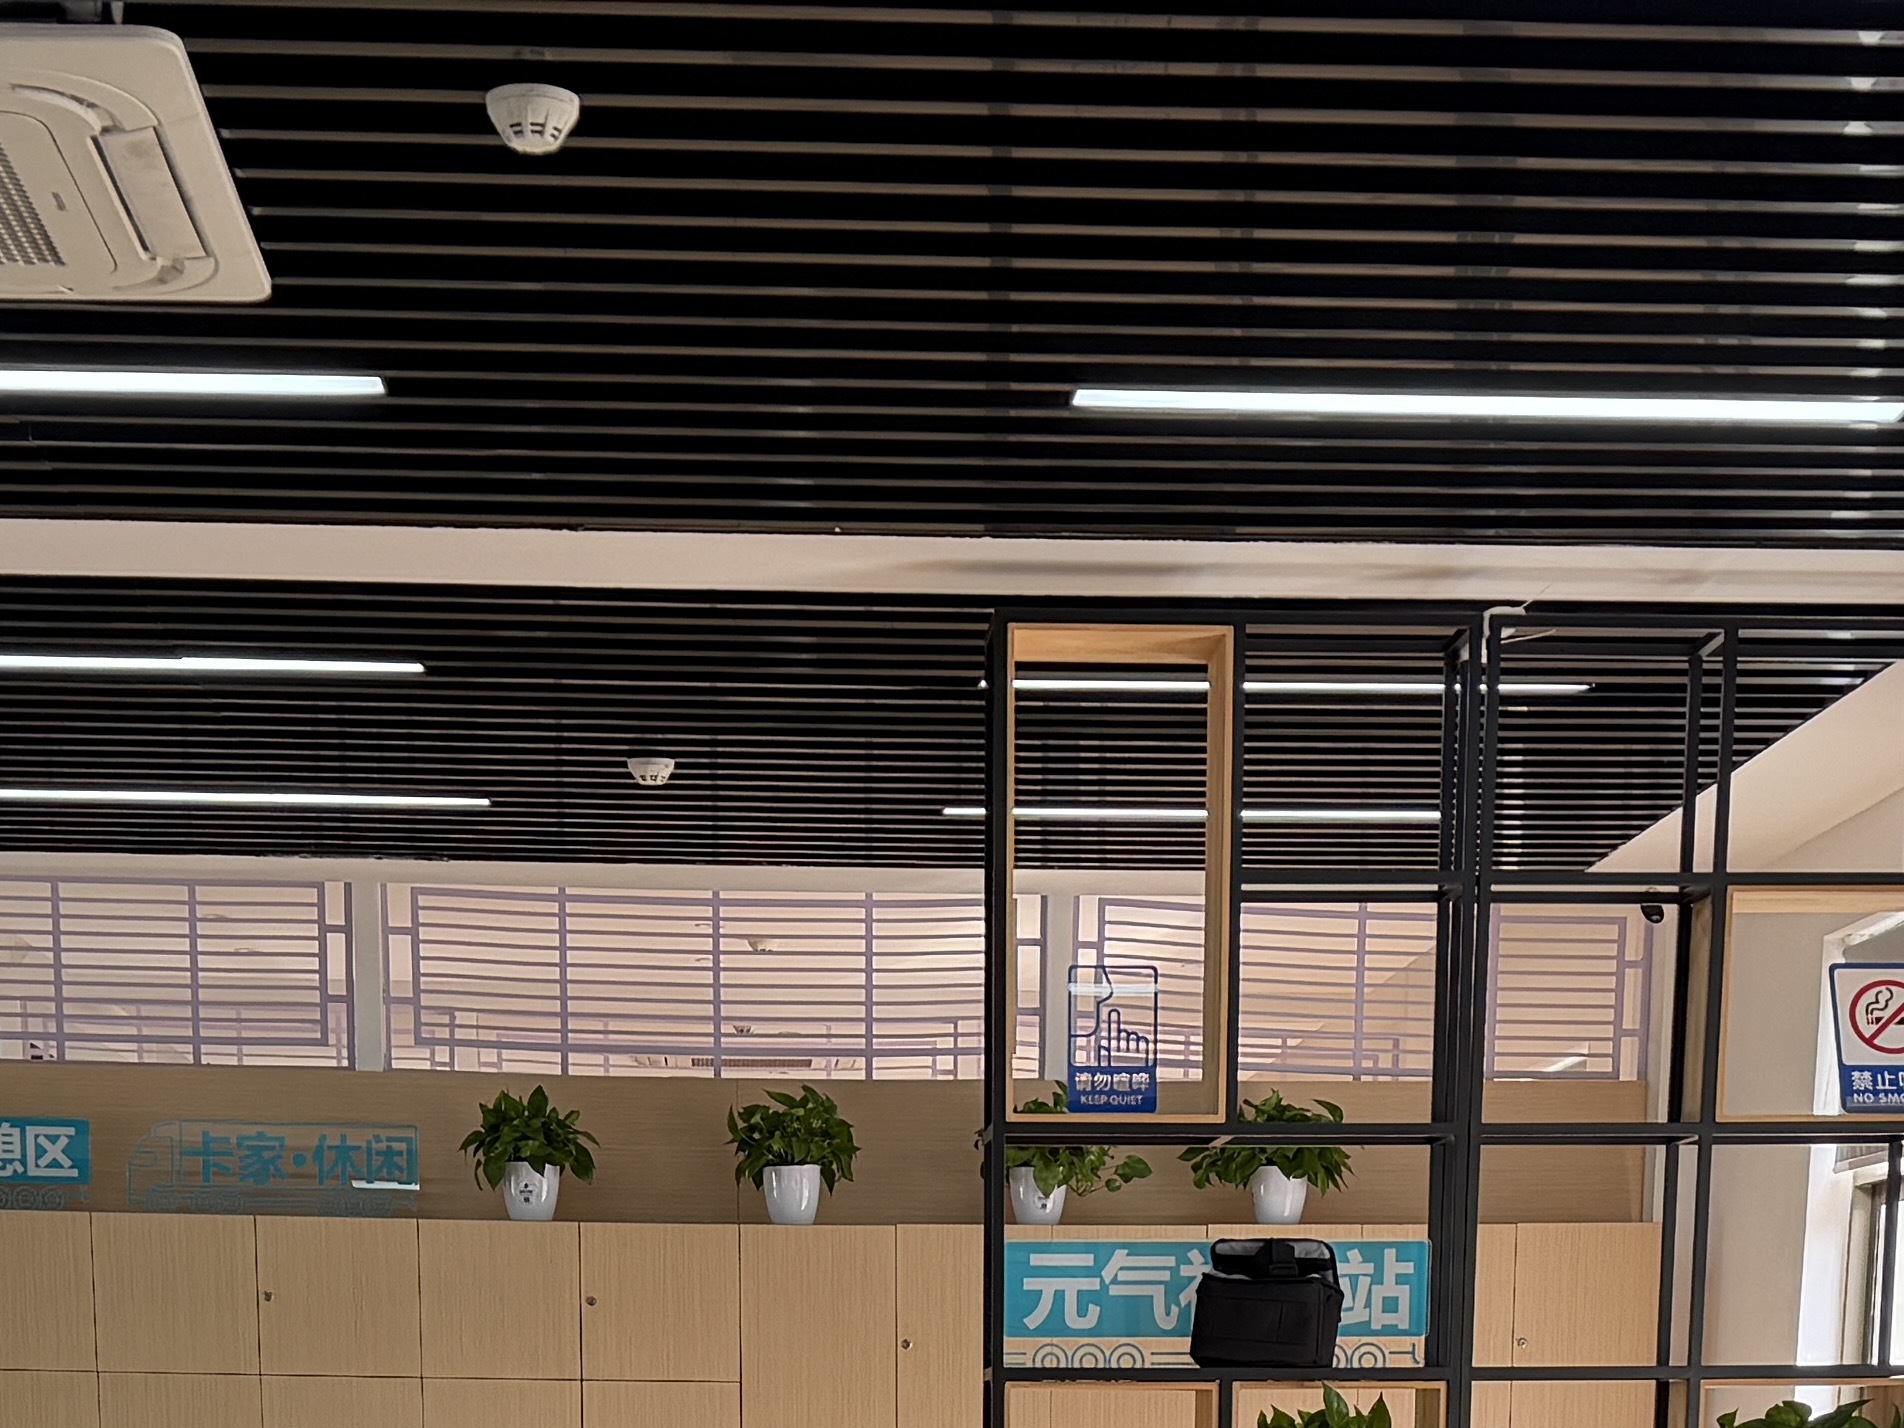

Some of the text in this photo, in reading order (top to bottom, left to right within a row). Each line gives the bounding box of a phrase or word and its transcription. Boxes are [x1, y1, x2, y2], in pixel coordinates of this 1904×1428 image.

[1074, 1072, 1150, 1092] 请勿喧哗
[1080, 1095, 1143, 1105] KEEP QUIET
[1853, 1092, 1874, 1103] NO
[180, 1130, 414, 1186] 卡家·休闲
[1022, 1248, 1416, 1331] 元气站
